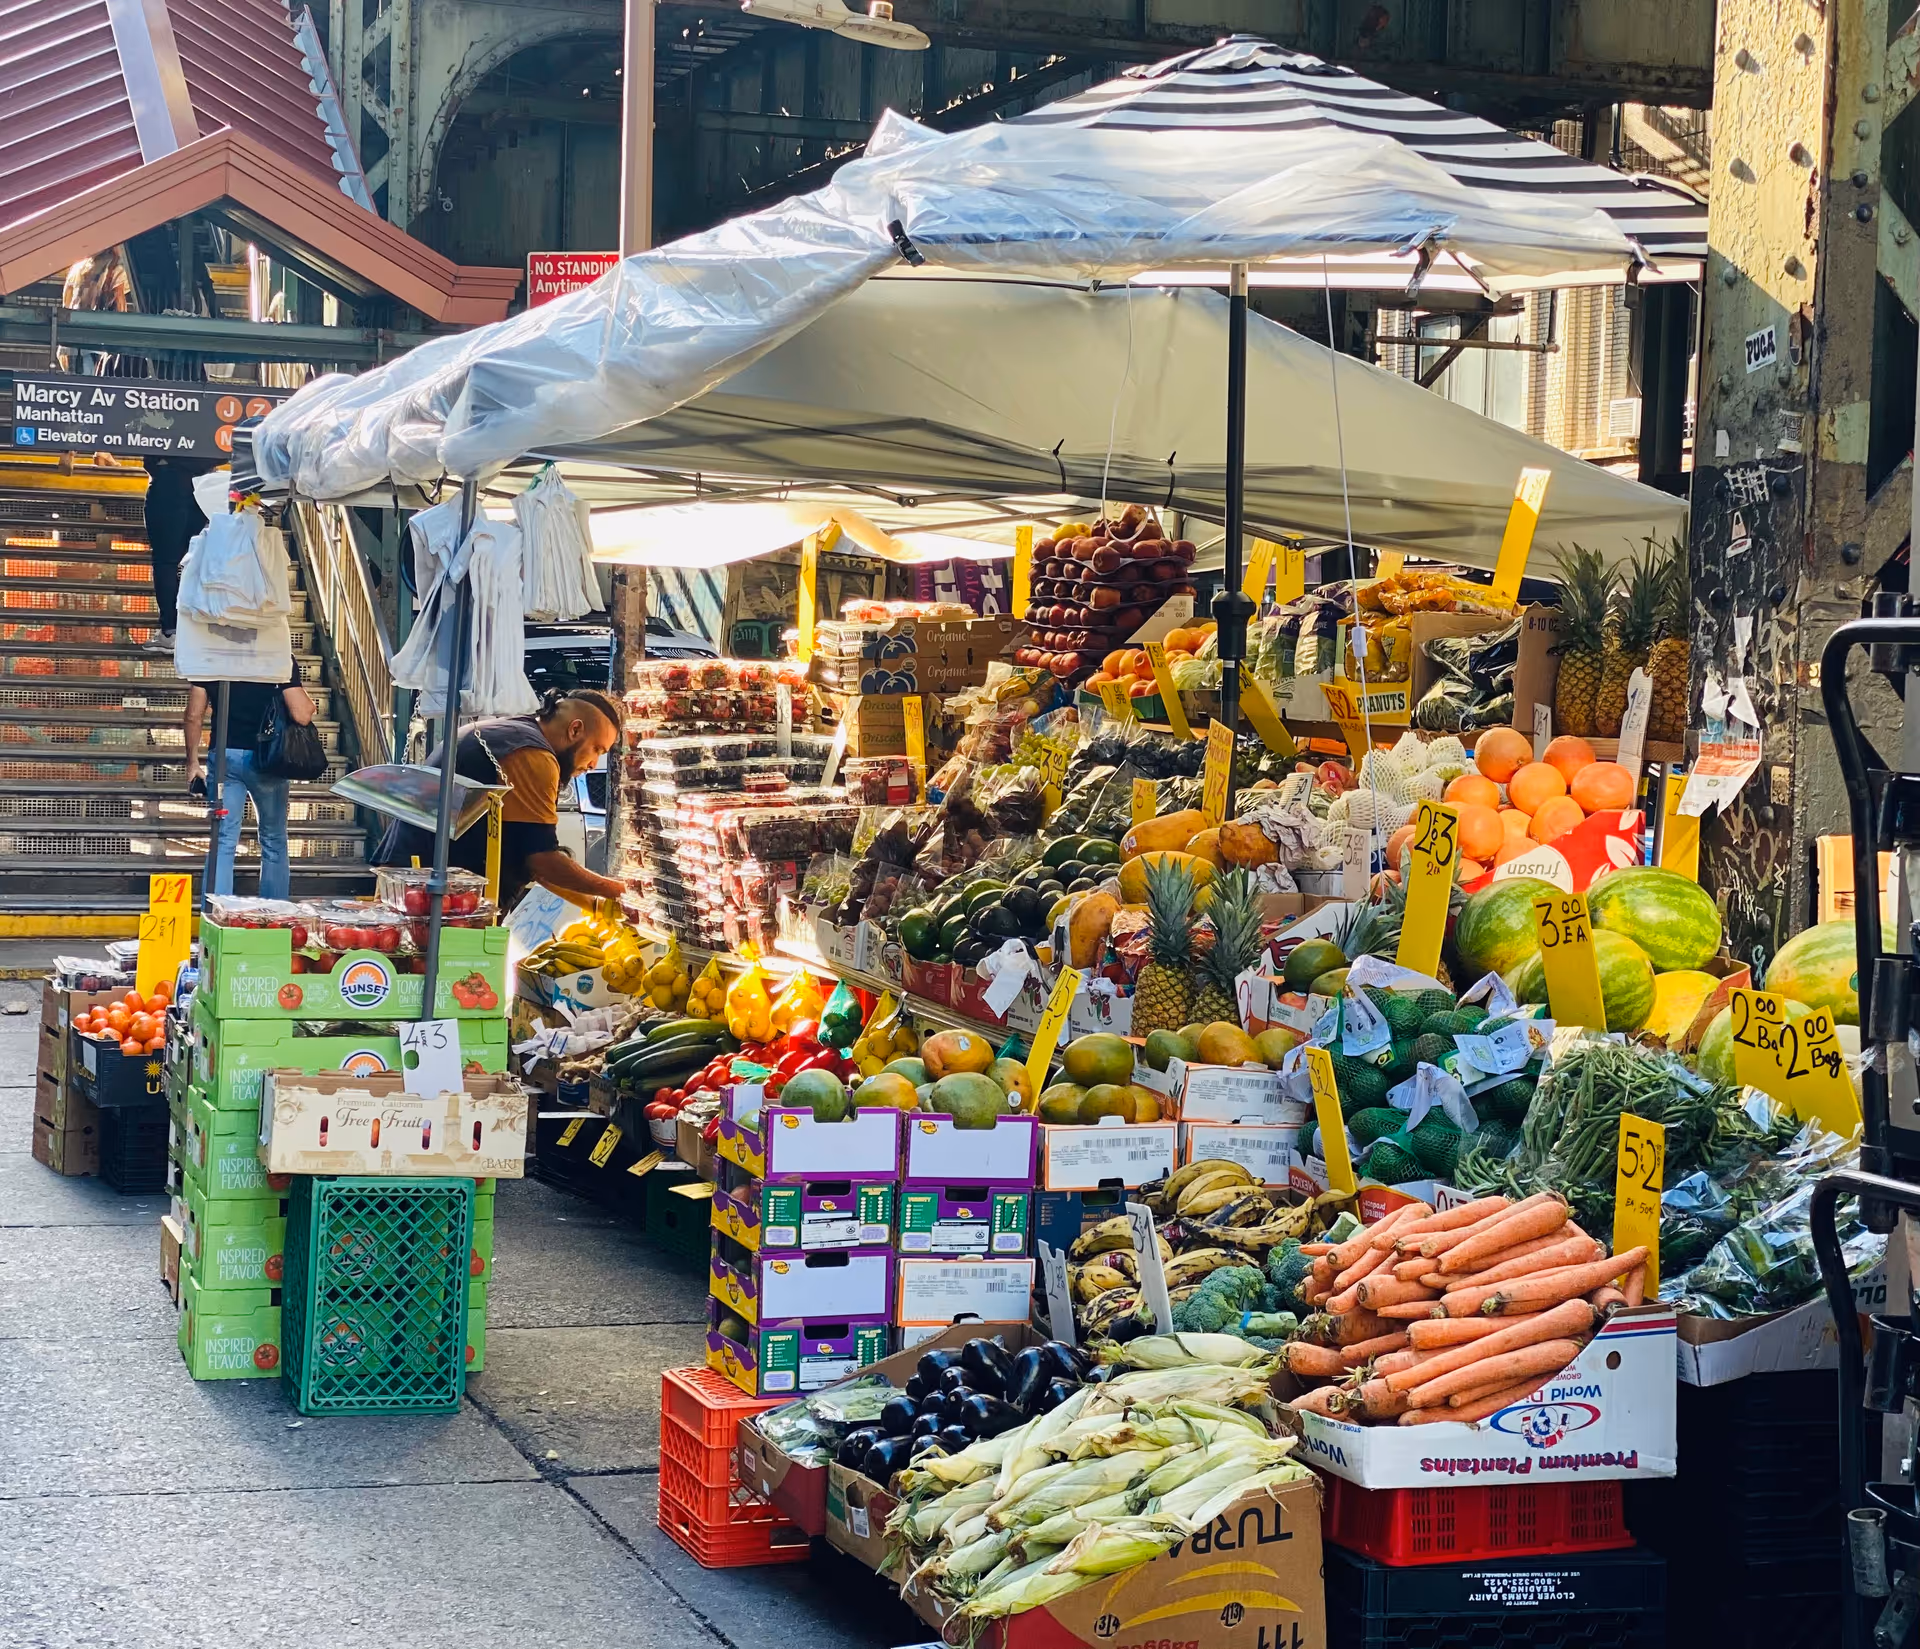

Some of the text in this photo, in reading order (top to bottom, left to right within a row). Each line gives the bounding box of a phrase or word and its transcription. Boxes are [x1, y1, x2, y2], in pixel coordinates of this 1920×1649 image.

[535, 261, 554, 275] NO
[16, 383, 200, 412] Marcy Av Station
[16, 406, 103, 425] Manhattan
[223, 401, 235, 417] J
[37, 428, 195, 451] Elevator on Marcy Av
[927, 630, 966, 649] Organic
[927, 665, 967, 684] Organic
[1326, 688, 1345, 719] 6
[1338, 690, 1360, 720] 2
[1041, 748, 1052, 786] 3
[1414, 804, 1433, 855] 2
[1435, 810, 1457, 867] 3
[1343, 833, 1354, 866] 3
[1354, 833, 1366, 846] 00
[1507, 860, 1562, 879] frusan
[153, 877, 168, 903] 2
[174, 878, 187, 903] 1
[140, 915, 157, 941] 2
[168, 916, 176, 948] 1
[1536, 898, 1581, 948] 3 00
[1563, 923, 1588, 945] EA
[230, 976, 279, 992] INSPIRED
[341, 983, 389, 997] SUNSET
[396, 979, 451, 995] TOMES
[1047, 968, 1067, 1012] 2
[232, 992, 275, 1008] FLAVOR
[1054, 973, 1078, 1018] 5
[1733, 992, 1776, 1048] 2 00
[402, 1023, 420, 1051] 4
[431, 1023, 447, 1049] 3
[1779, 1015, 1827, 1080] 2 00
[1811, 1047, 1842, 1079] Bag
[229, 1068, 262, 1084] INSPI
[1306, 1053, 1335, 1101] 3 2
[232, 1084, 259, 1100] FLAV
[337, 1097, 424, 1108] Premium California
[335, 1106, 422, 1128] Tree Fruit
[1620, 1131, 1640, 1178] 5
[1642, 1140, 1661, 1193] 2
[221, 1173, 263, 1189] FLAVOR
[1291, 1174, 1315, 1193] MEXICO
[1128, 1212, 1145, 1254] 3
[216, 1248, 265, 1264] INSPIRED
[219, 1264, 262, 1280] FLAVOR
[205, 1338, 254, 1353] INSPIRED
[208, 1353, 251, 1369] FLAVOR
[1553, 1372, 1582, 1381] GROWE
[1550, 1384, 1602, 1402] World
[1419, 1448, 1639, 1477] Premium Plantains
[1152, 1502, 1293, 1563] TURBA
[1484, 1578, 1562, 1586] 1-800-323-0123
[1507, 1585, 1555, 1593] READING,
[1468, 1593, 1498, 1601] DAIRY
[1537, 1592, 1575, 1600] CLOVER
